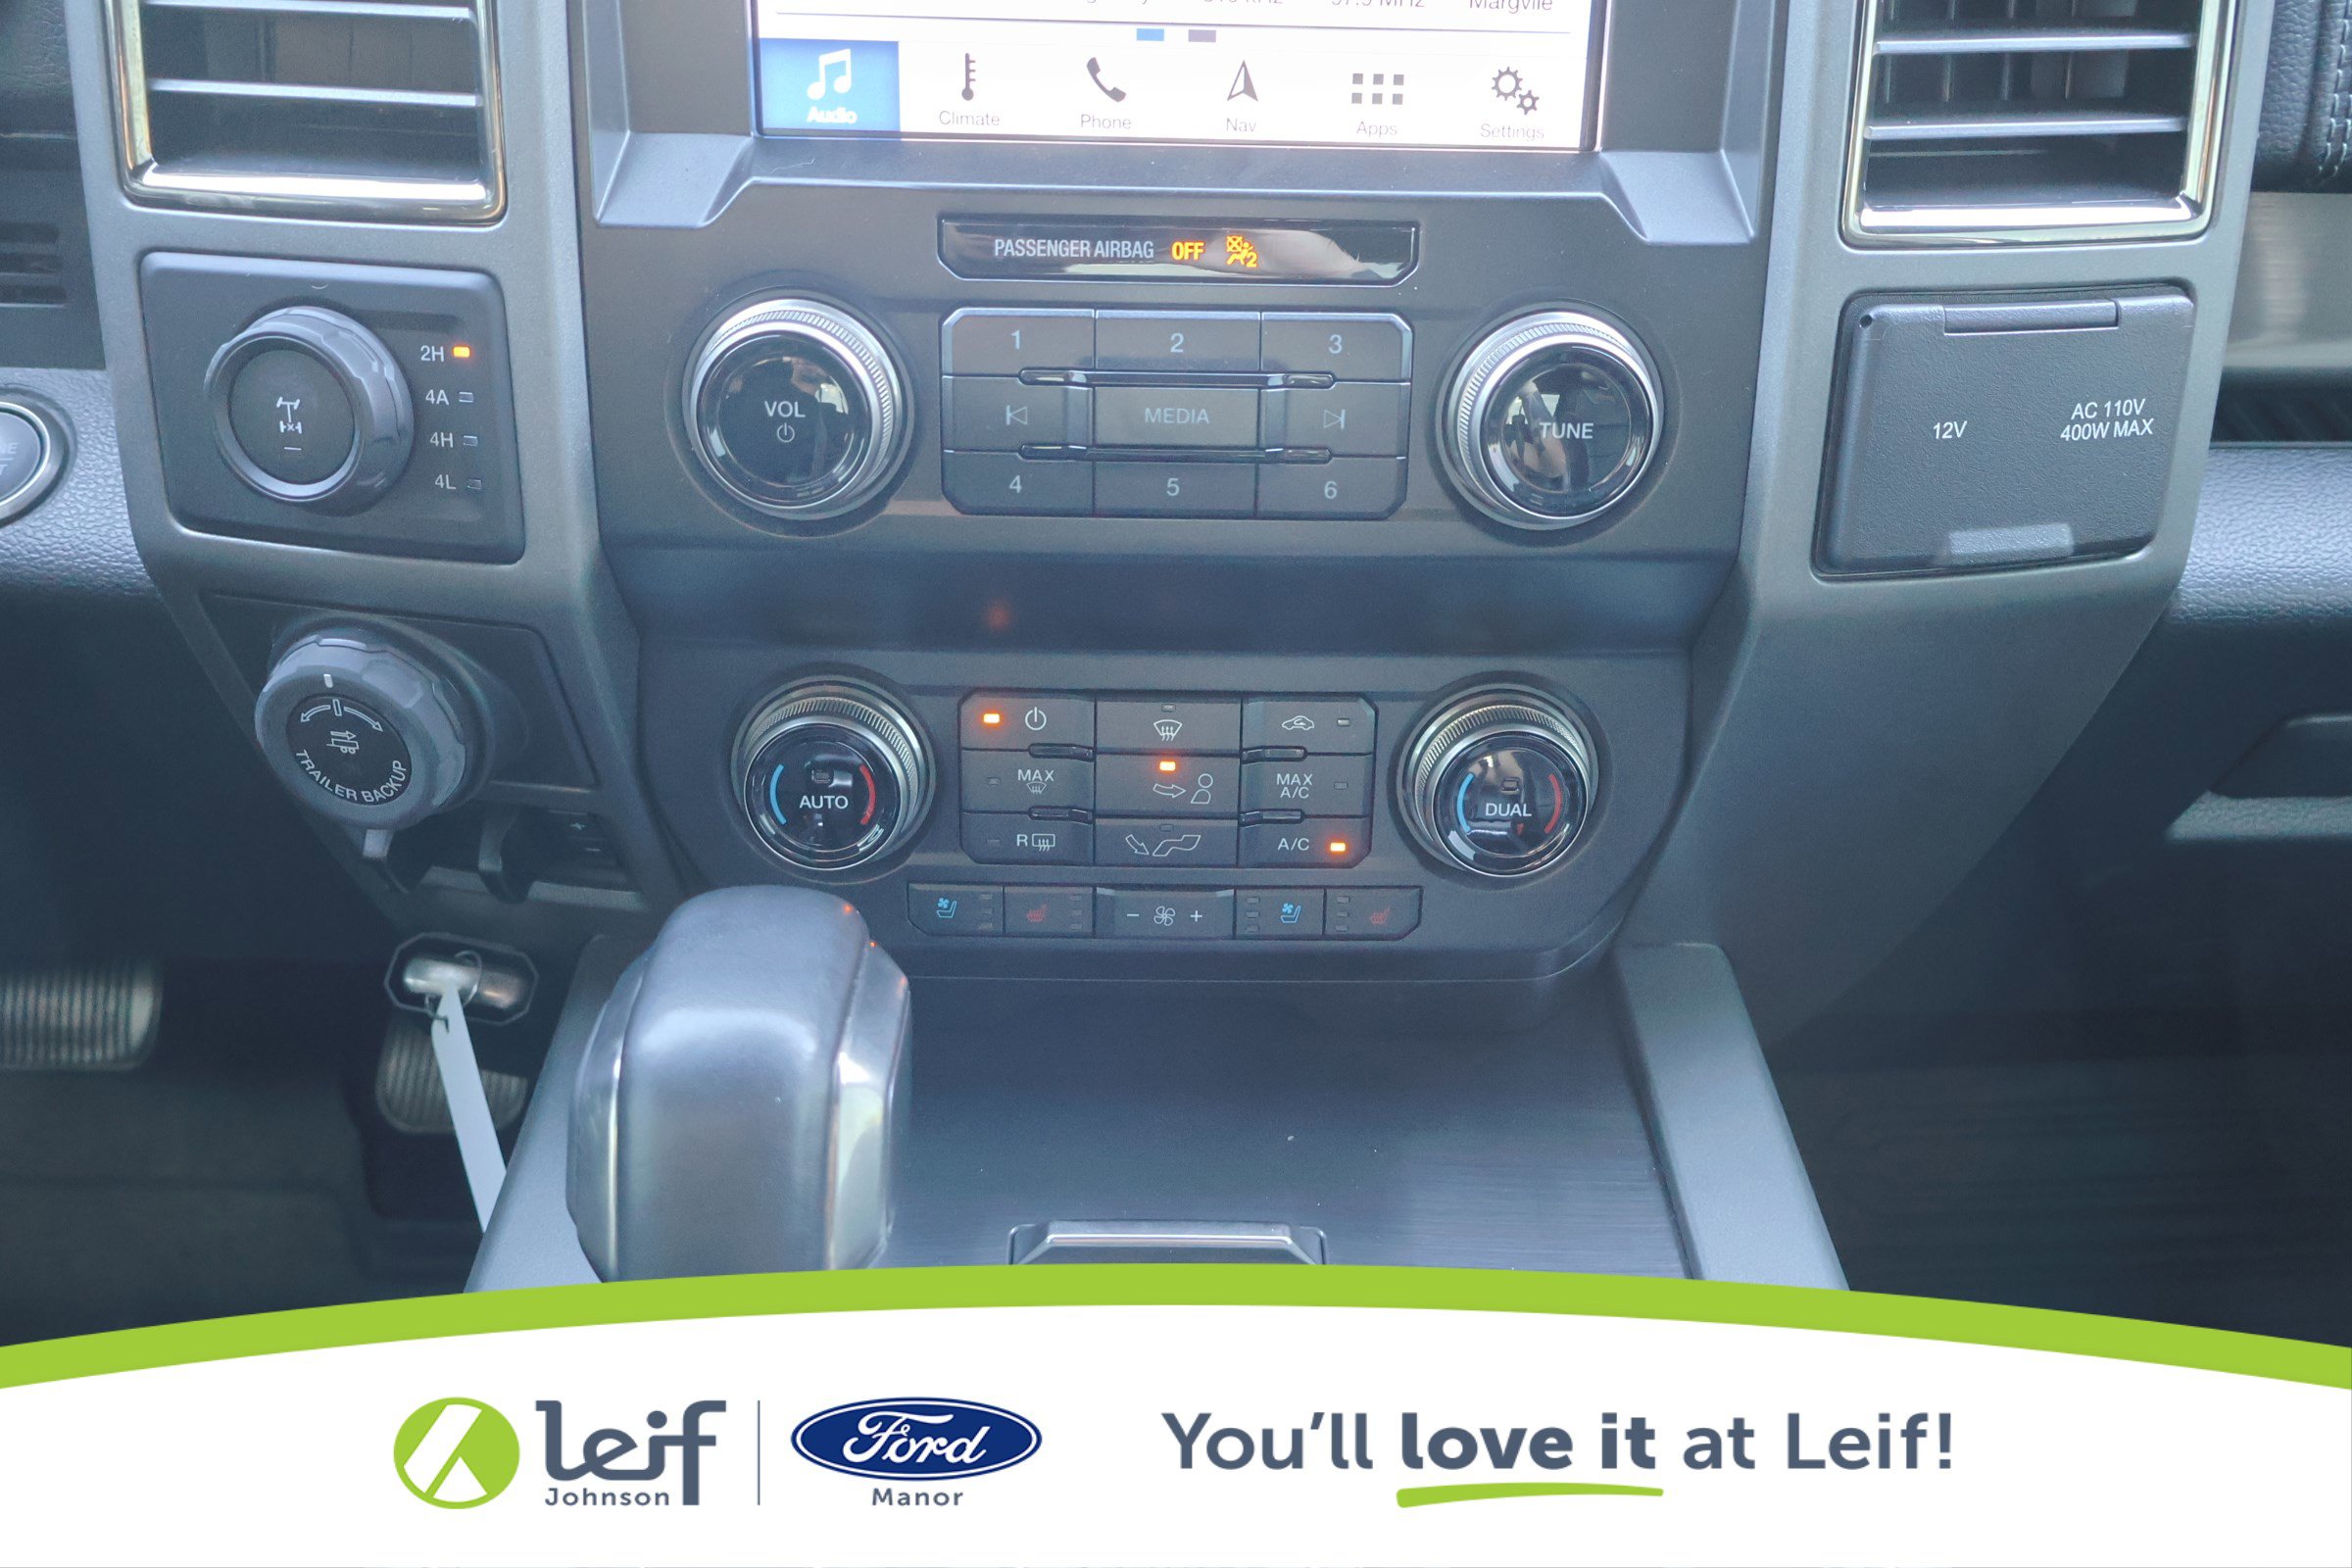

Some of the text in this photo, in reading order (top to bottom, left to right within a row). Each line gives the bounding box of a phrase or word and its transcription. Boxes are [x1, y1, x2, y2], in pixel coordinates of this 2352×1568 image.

[807, 107, 858, 124] Audio
[939, 110, 1001, 126] Climate
[1080, 114, 1132, 129] Phone
[1226, 118, 1257, 133] Nav
[1356, 121, 1398, 136] Apps
[1480, 122, 1545, 140] Settings
[994, 238, 1154, 259] PASSENGER AIRBAG
[1170, 241, 1204, 261] OFF
[1012, 331, 1021, 349] 1
[1169, 333, 1185, 352] 2
[1328, 335, 1343, 354] 3
[420, 345, 445, 363] 2H
[425, 389, 450, 406] 4A
[764, 400, 807, 418] VOL
[1145, 408, 1210, 424] MEDIA
[2070, 398, 2146, 419] AC 110V
[1540, 422, 1594, 439] TUNE
[1933, 420, 1968, 440] 12V
[2060, 418, 2154, 441] 400W MAX
[429, 432, 454, 448] 4H
[434, 474, 457, 490] 4L
[1008, 475, 1023, 493] 4
[1165, 479, 1180, 497] 5
[1323, 481, 1338, 500] 6
[296, 750, 407, 804] TRAILER BACKUP
[1017, 768, 1054, 782] MAX
[1276, 772, 1313, 786] MAX
[799, 795, 849, 809] AUTO
[1280, 787, 1309, 800] A/C
[1485, 803, 1532, 817] DUAL
[1016, 833, 1028, 848] R
[1278, 838, 1310, 852] A/C
